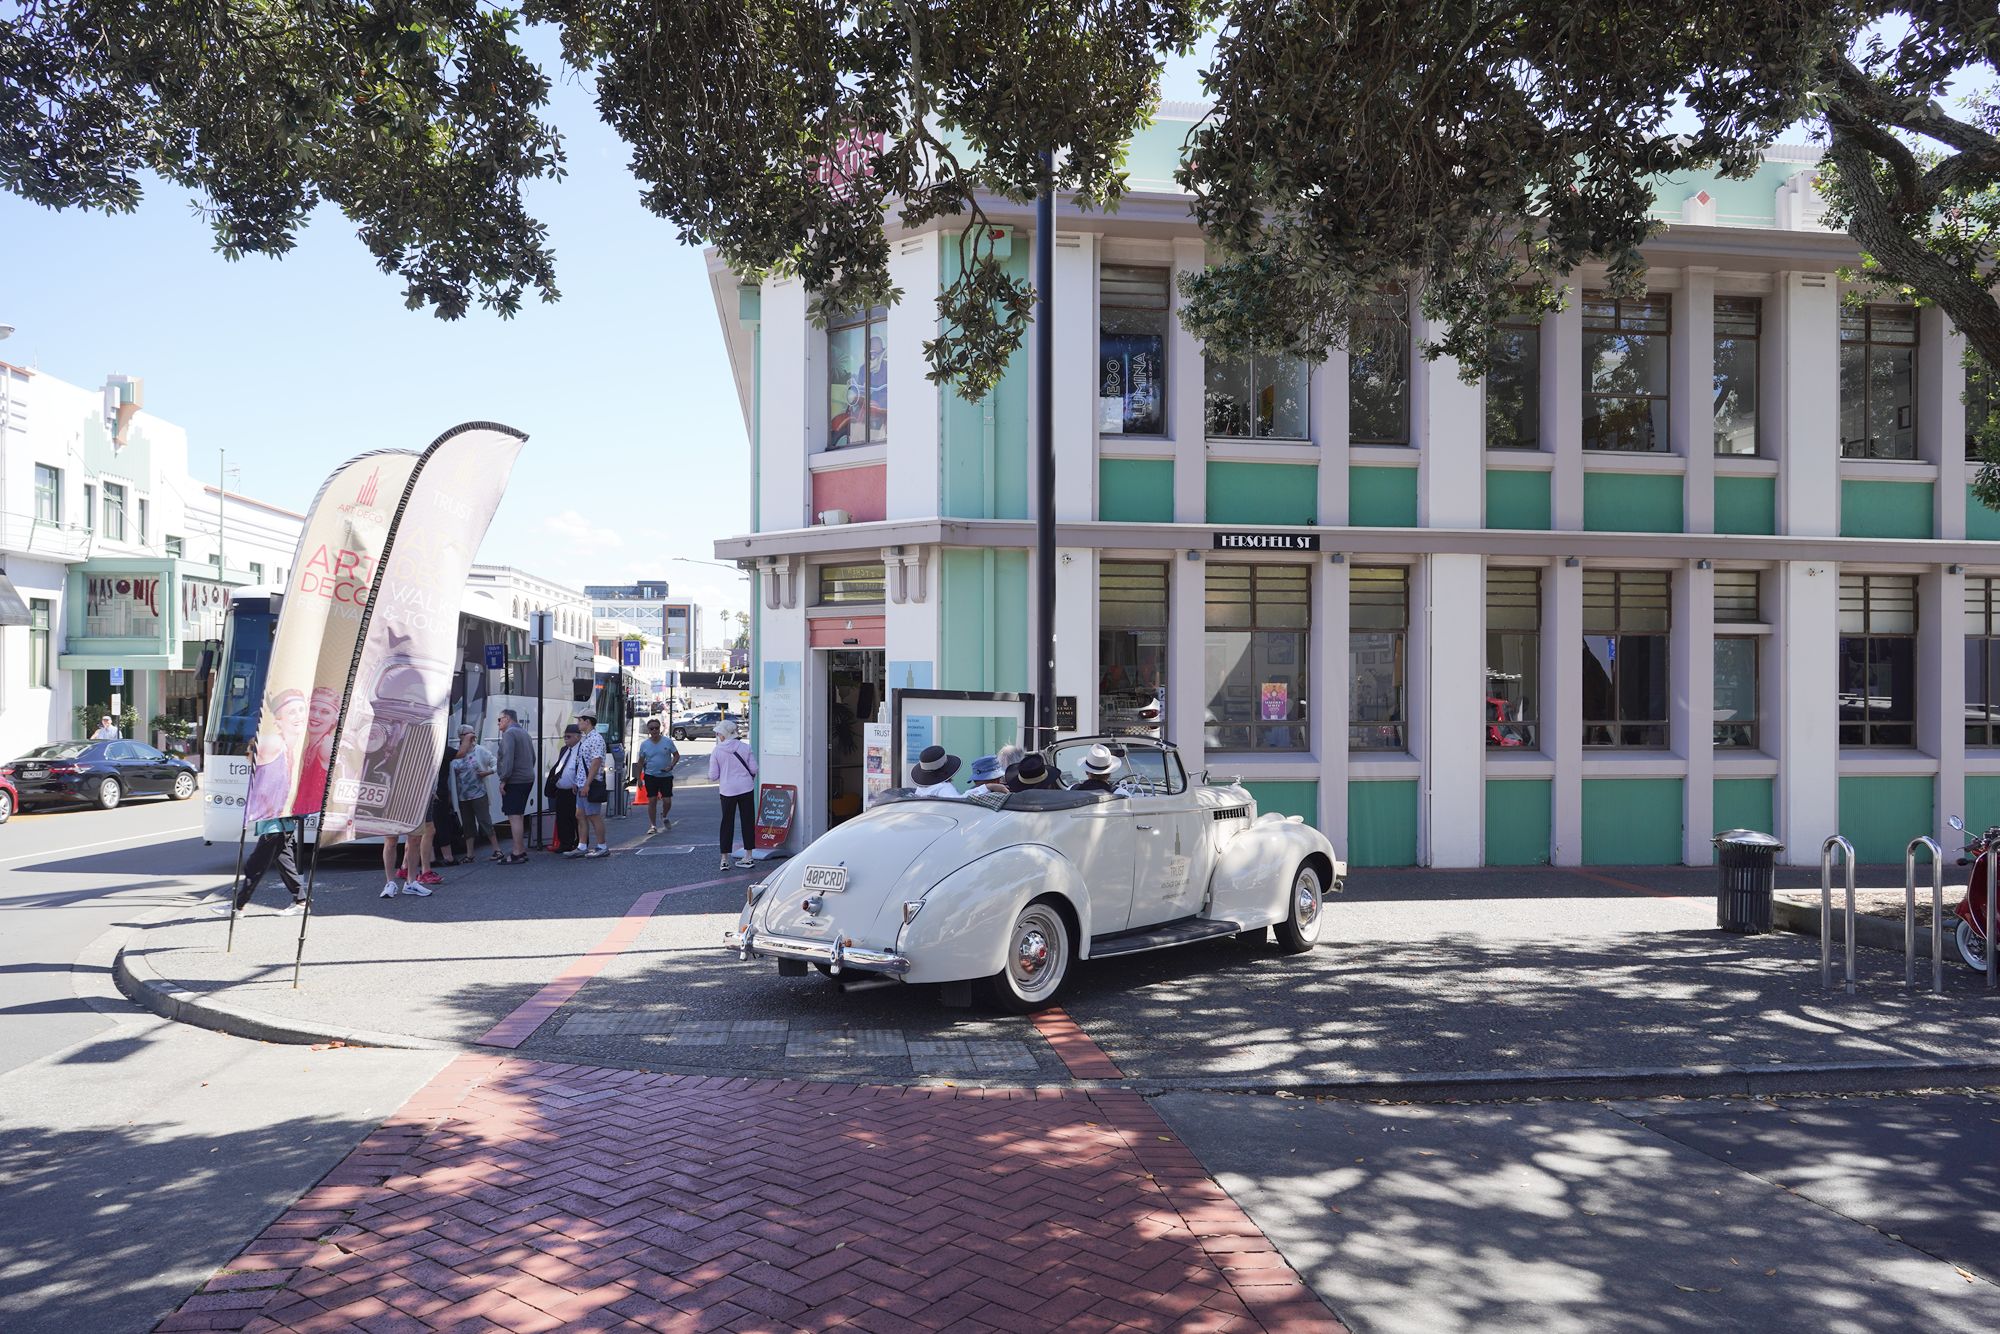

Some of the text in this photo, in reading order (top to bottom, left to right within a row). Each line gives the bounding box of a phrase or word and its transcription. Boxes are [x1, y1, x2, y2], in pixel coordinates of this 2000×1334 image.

[1106, 360, 1120, 397] ECO
[1133, 352, 1147, 417] LUMINA
[336, 503, 384, 524] ART DECO
[1221, 535, 1312, 549] HERSCHELL ST
[305, 543, 382, 584] ART
[87, 578, 160, 618] MASONIC
[181, 581, 230, 621] MASON
[382, 604, 399, 621] &
[715, 671, 750, 689] Henderson
[873, 729, 890, 737] TRUST
[337, 782, 386, 803] HZS285
[806, 869, 844, 887] 40PCRD
